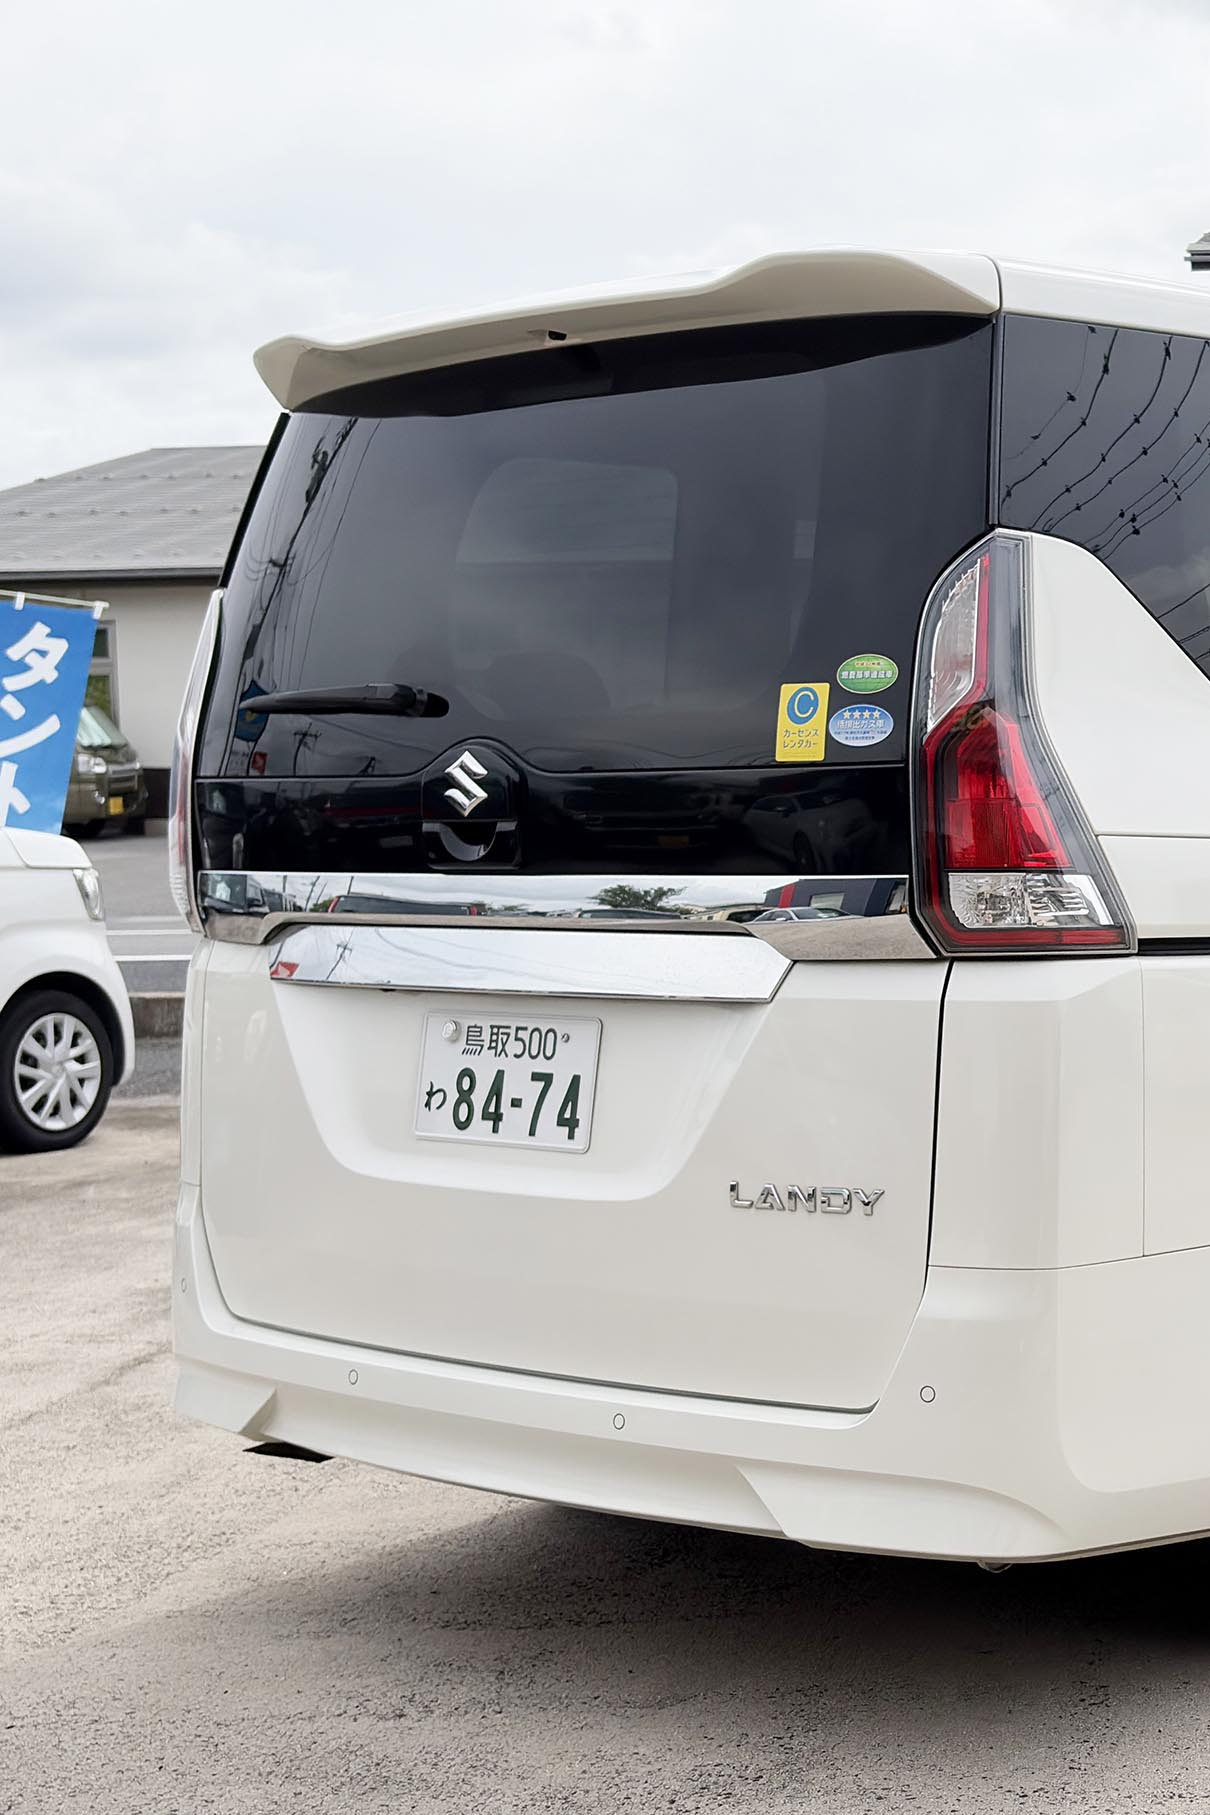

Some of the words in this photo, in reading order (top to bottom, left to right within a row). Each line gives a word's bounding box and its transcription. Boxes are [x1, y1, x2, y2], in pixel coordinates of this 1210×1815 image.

[783, 728, 820, 738] カーセンス
[783, 739, 818, 749] レンタカー
[424, 1081, 447, 1112] わ
[452, 1067, 582, 1140] 84-74
[729, 1180, 886, 1216] LANDY
